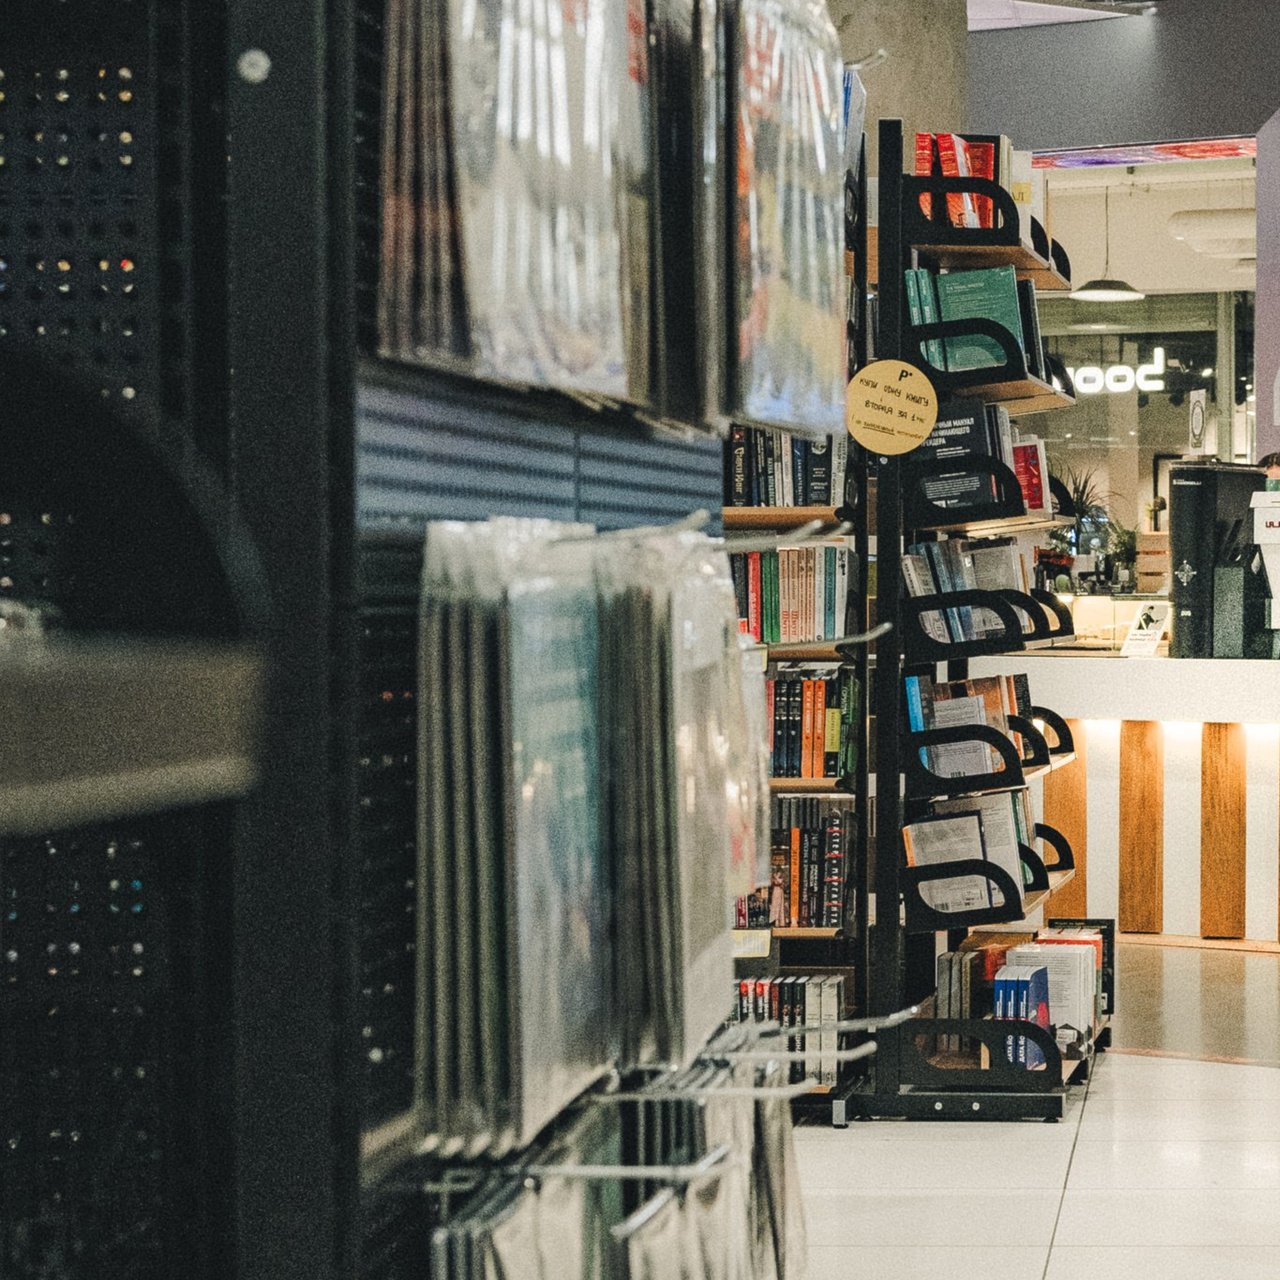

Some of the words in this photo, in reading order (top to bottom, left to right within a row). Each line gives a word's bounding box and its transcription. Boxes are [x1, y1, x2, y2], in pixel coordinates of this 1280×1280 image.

[860, 378, 878, 389] КУПИ
[884, 385, 901, 397] ОДНУ
[906, 392, 929, 407] КНИГУ
[865, 400, 893, 415] ВТОРАЯ
[897, 410, 907, 419] ЗА
